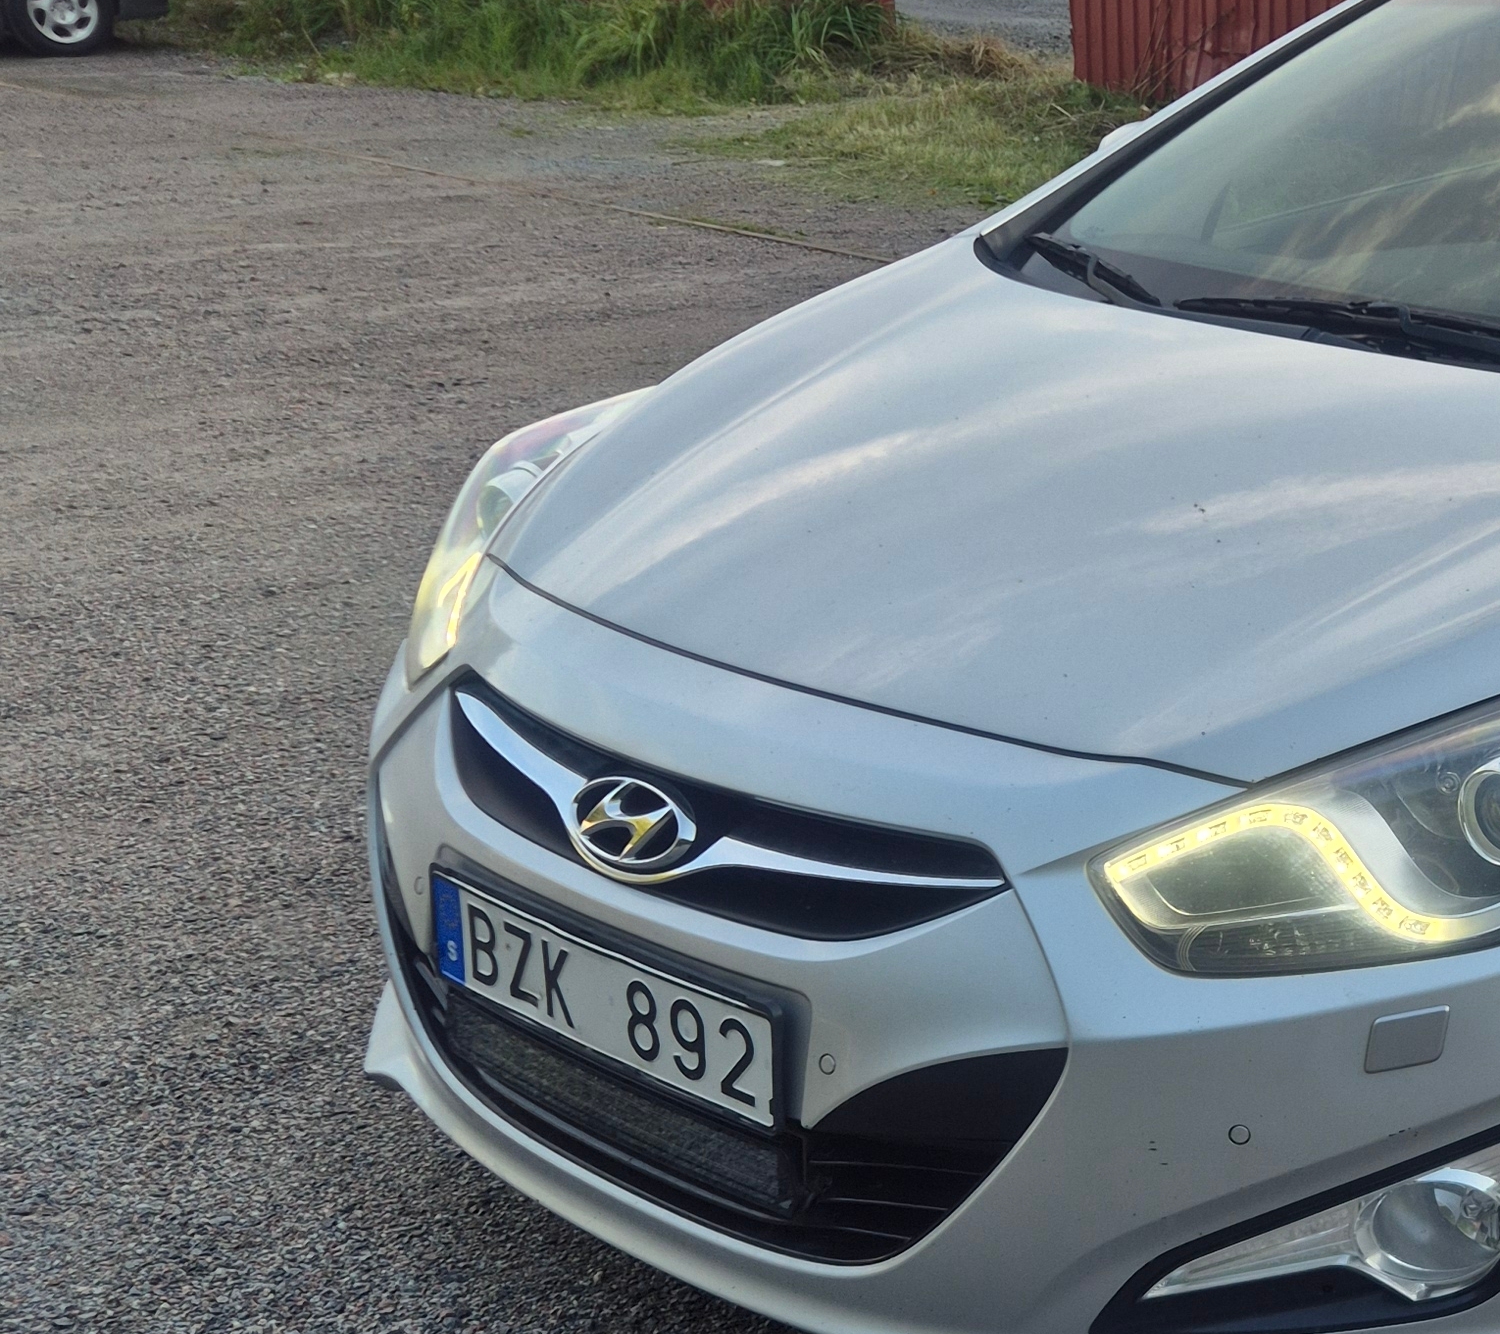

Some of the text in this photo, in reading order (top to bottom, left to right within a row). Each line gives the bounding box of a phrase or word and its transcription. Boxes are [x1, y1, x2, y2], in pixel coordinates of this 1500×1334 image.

[447, 940, 458, 962] S
[467, 903, 756, 1107] BZK 892
